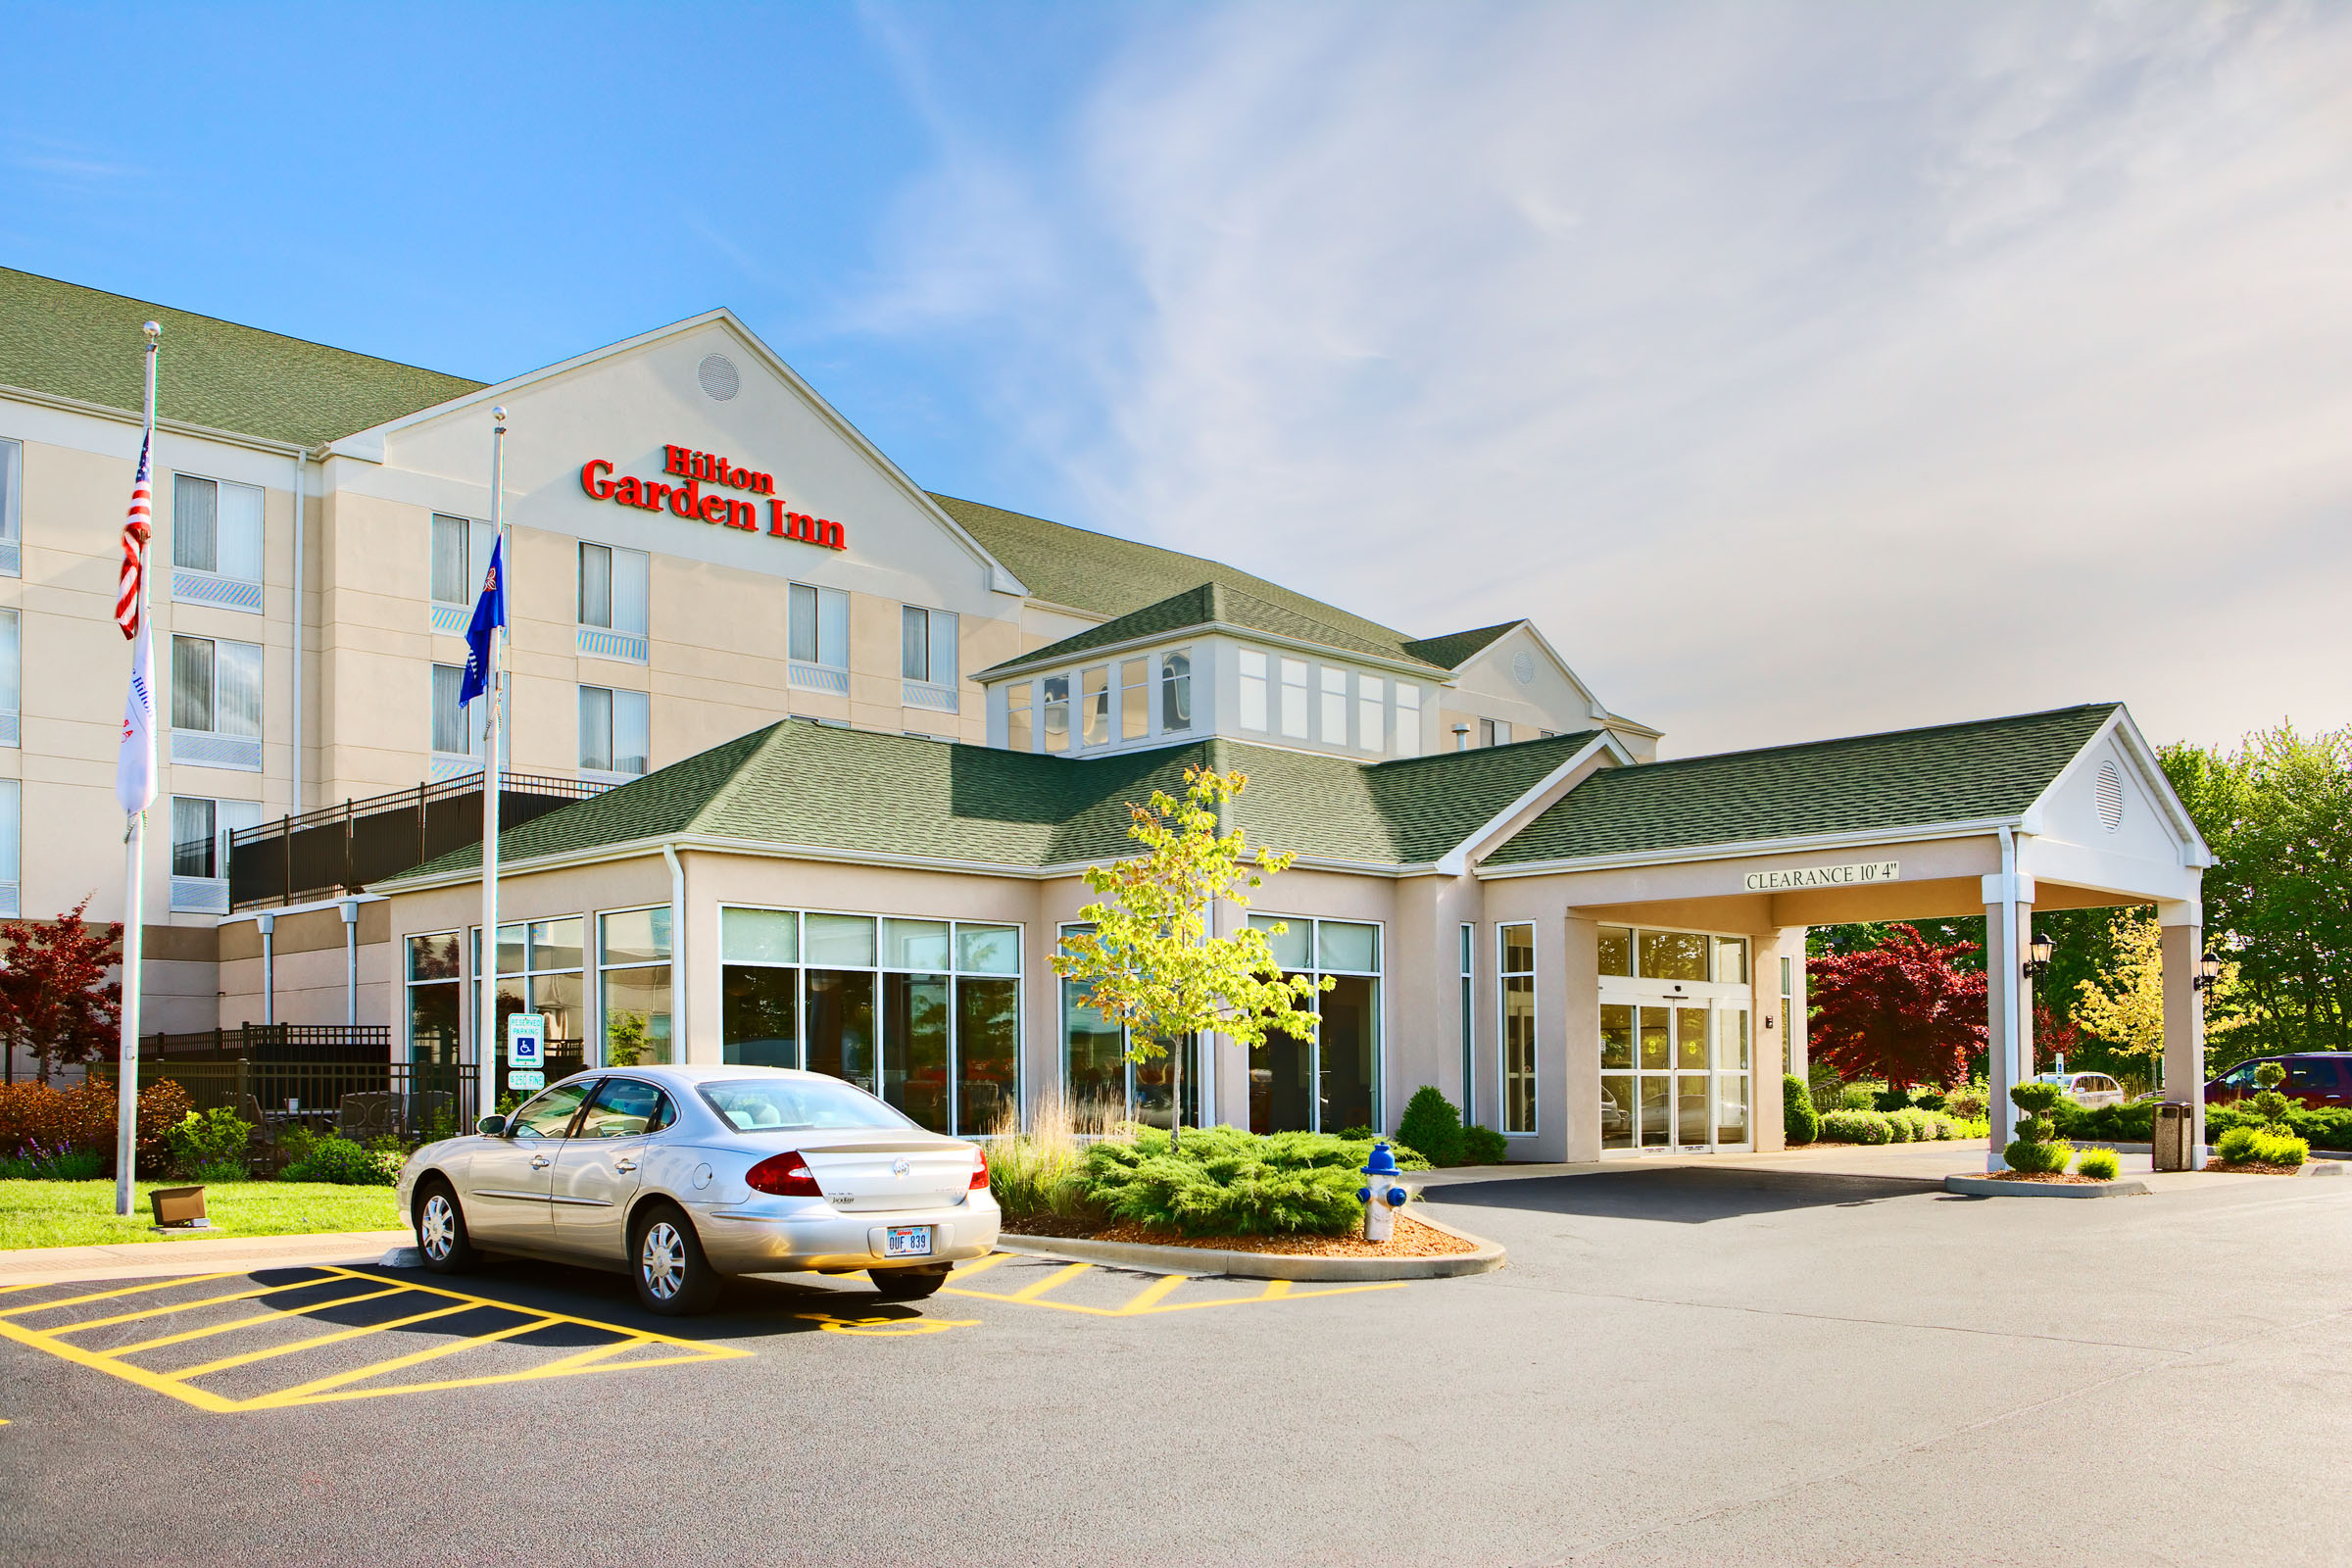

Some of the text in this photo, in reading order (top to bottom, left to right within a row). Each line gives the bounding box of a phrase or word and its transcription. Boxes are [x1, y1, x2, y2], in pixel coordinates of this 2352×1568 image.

[662, 444, 775, 495] Hilton
[580, 459, 847, 551] Garden Inn
[1747, 862, 1897, 890] CLEARANCE 10' 4"
[529, 1075, 543, 1086] FINE
[909, 1234, 926, 1249] 839
